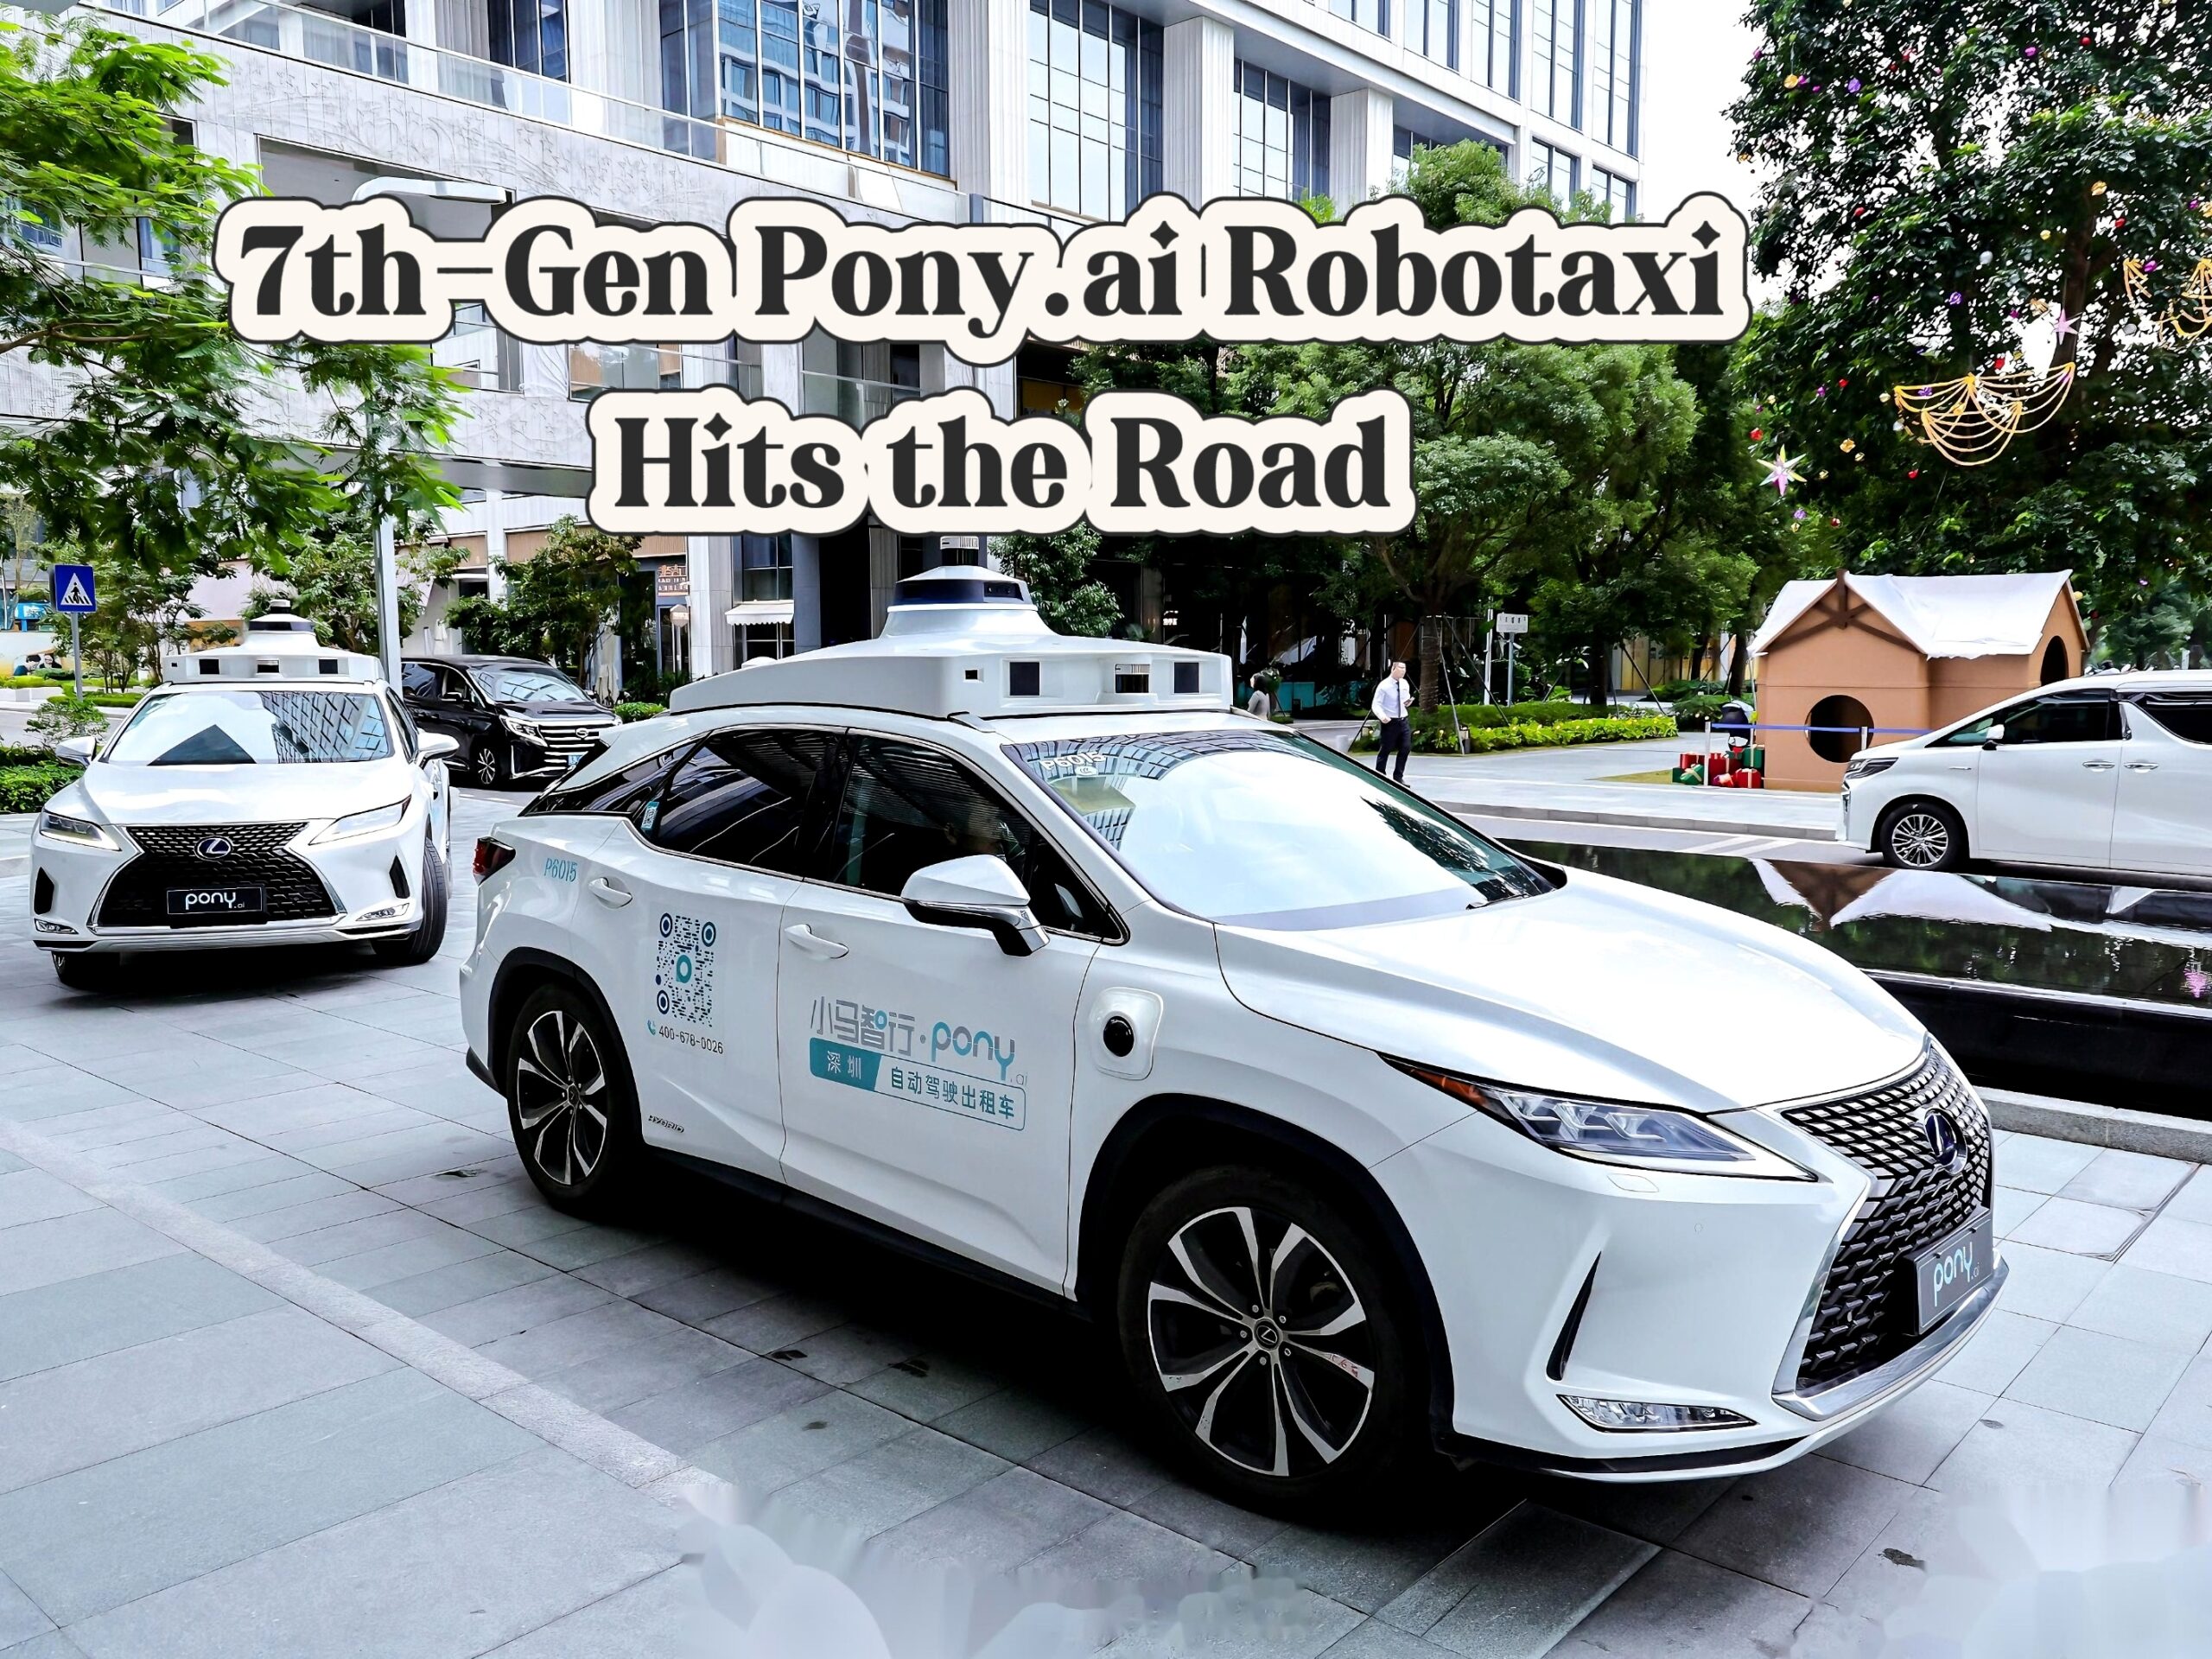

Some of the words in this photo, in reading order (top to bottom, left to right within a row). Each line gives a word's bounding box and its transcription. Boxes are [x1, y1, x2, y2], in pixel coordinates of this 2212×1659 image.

[1039, 751, 1106, 771] P6015
[543, 857, 578, 882] P6015
[658, 1025, 723, 1054] 400-678-0026
[891, 1065, 1015, 1120] 自动驾驶出租车
